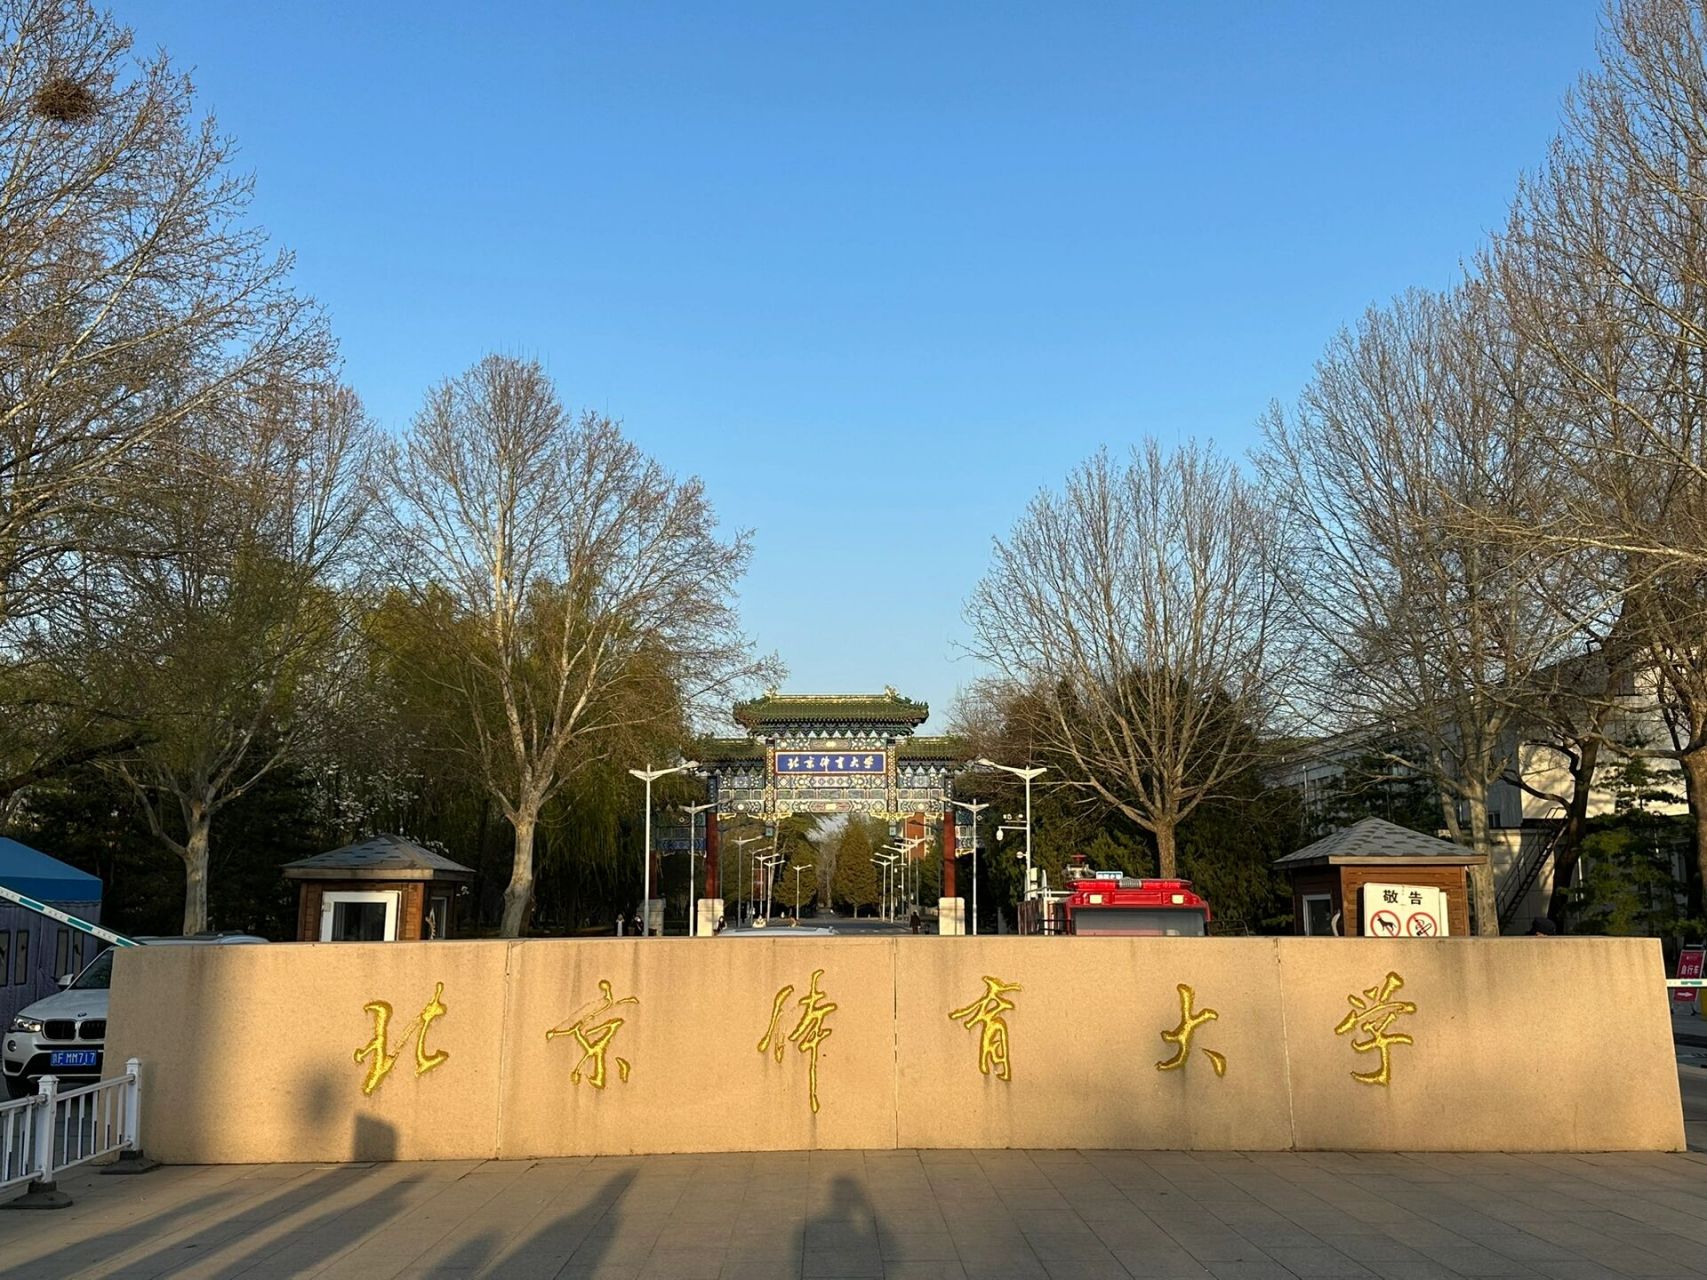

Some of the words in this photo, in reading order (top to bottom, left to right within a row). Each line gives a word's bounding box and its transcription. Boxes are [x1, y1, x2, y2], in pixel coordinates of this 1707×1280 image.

[787, 755, 874, 772] 北京体育大学
[1383, 889, 1423, 905] 敬告
[355, 968, 1417, 1114] 北京体育大学
